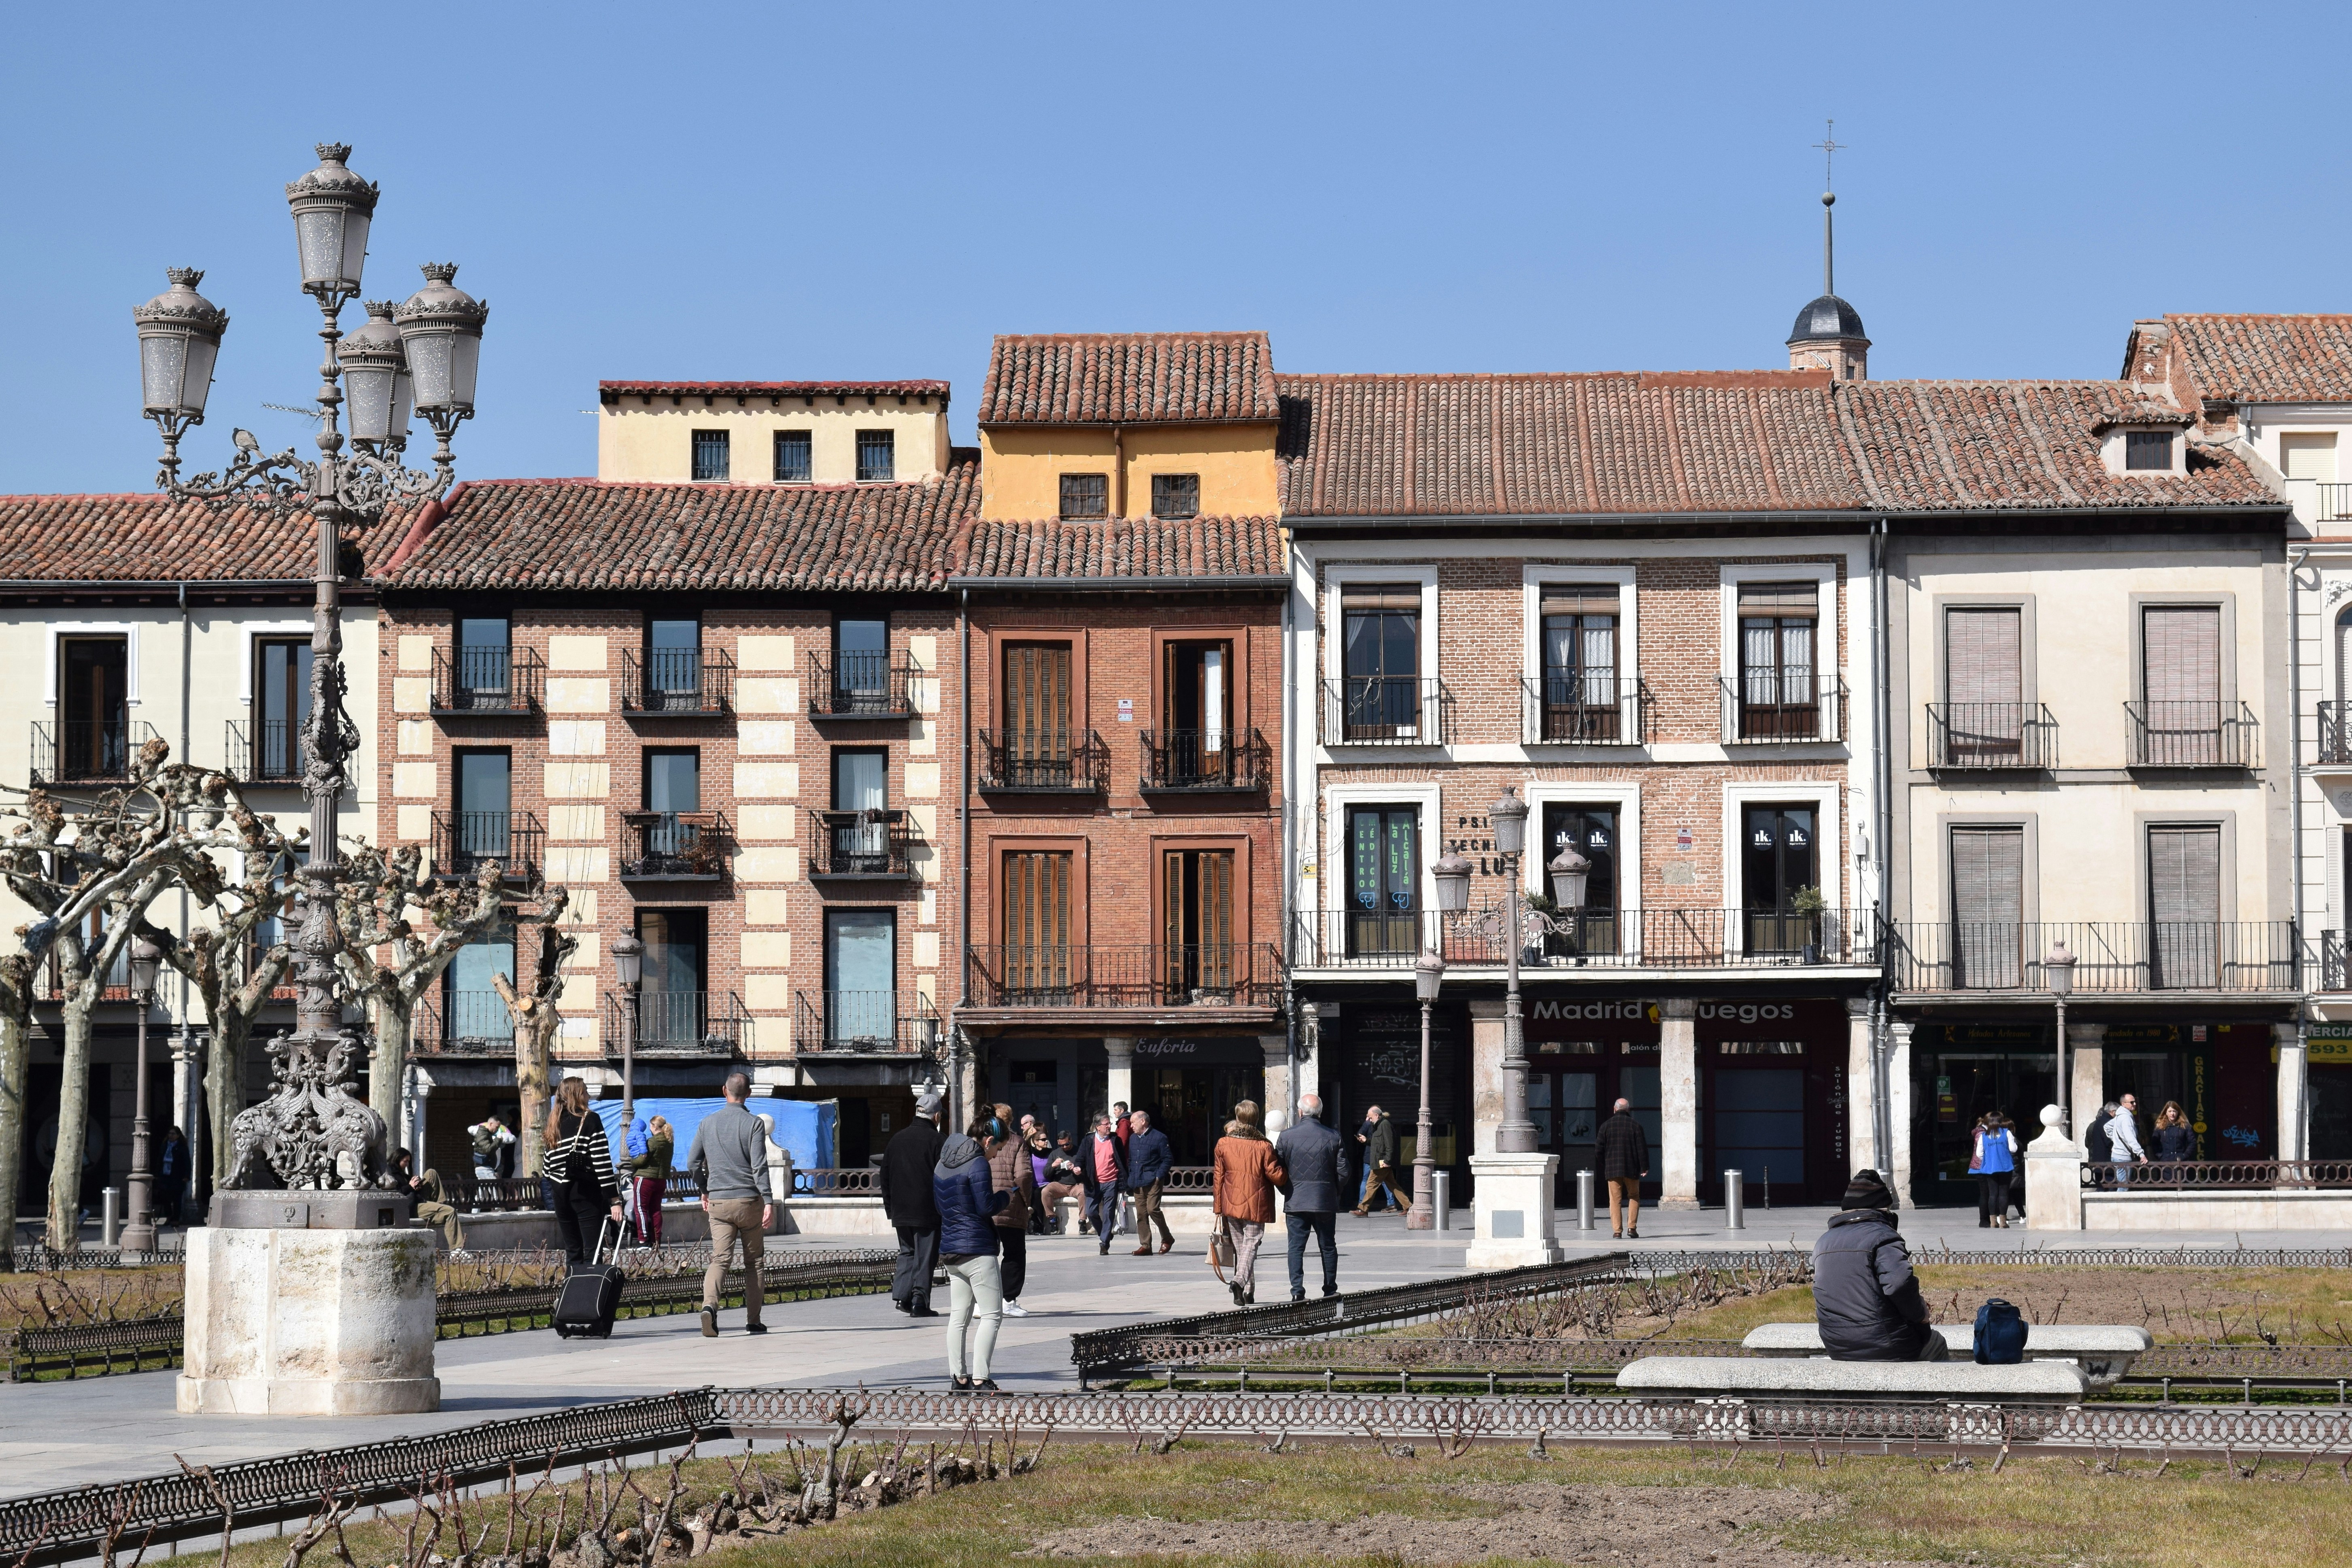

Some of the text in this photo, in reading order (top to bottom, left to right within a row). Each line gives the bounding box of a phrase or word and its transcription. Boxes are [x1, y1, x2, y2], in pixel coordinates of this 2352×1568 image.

[1392, 818, 1398, 838] La
[1459, 816, 1487, 828] PSI
[1449, 839, 1498, 851] TECNI
[1481, 857, 1506, 876] LU
[1533, 1001, 1793, 1023] Madrid uegos
[1136, 1038, 1197, 1057] Euforia
[2310, 1045, 2348, 1054] 593
[2194, 1056, 2204, 1121] GRACIAS
